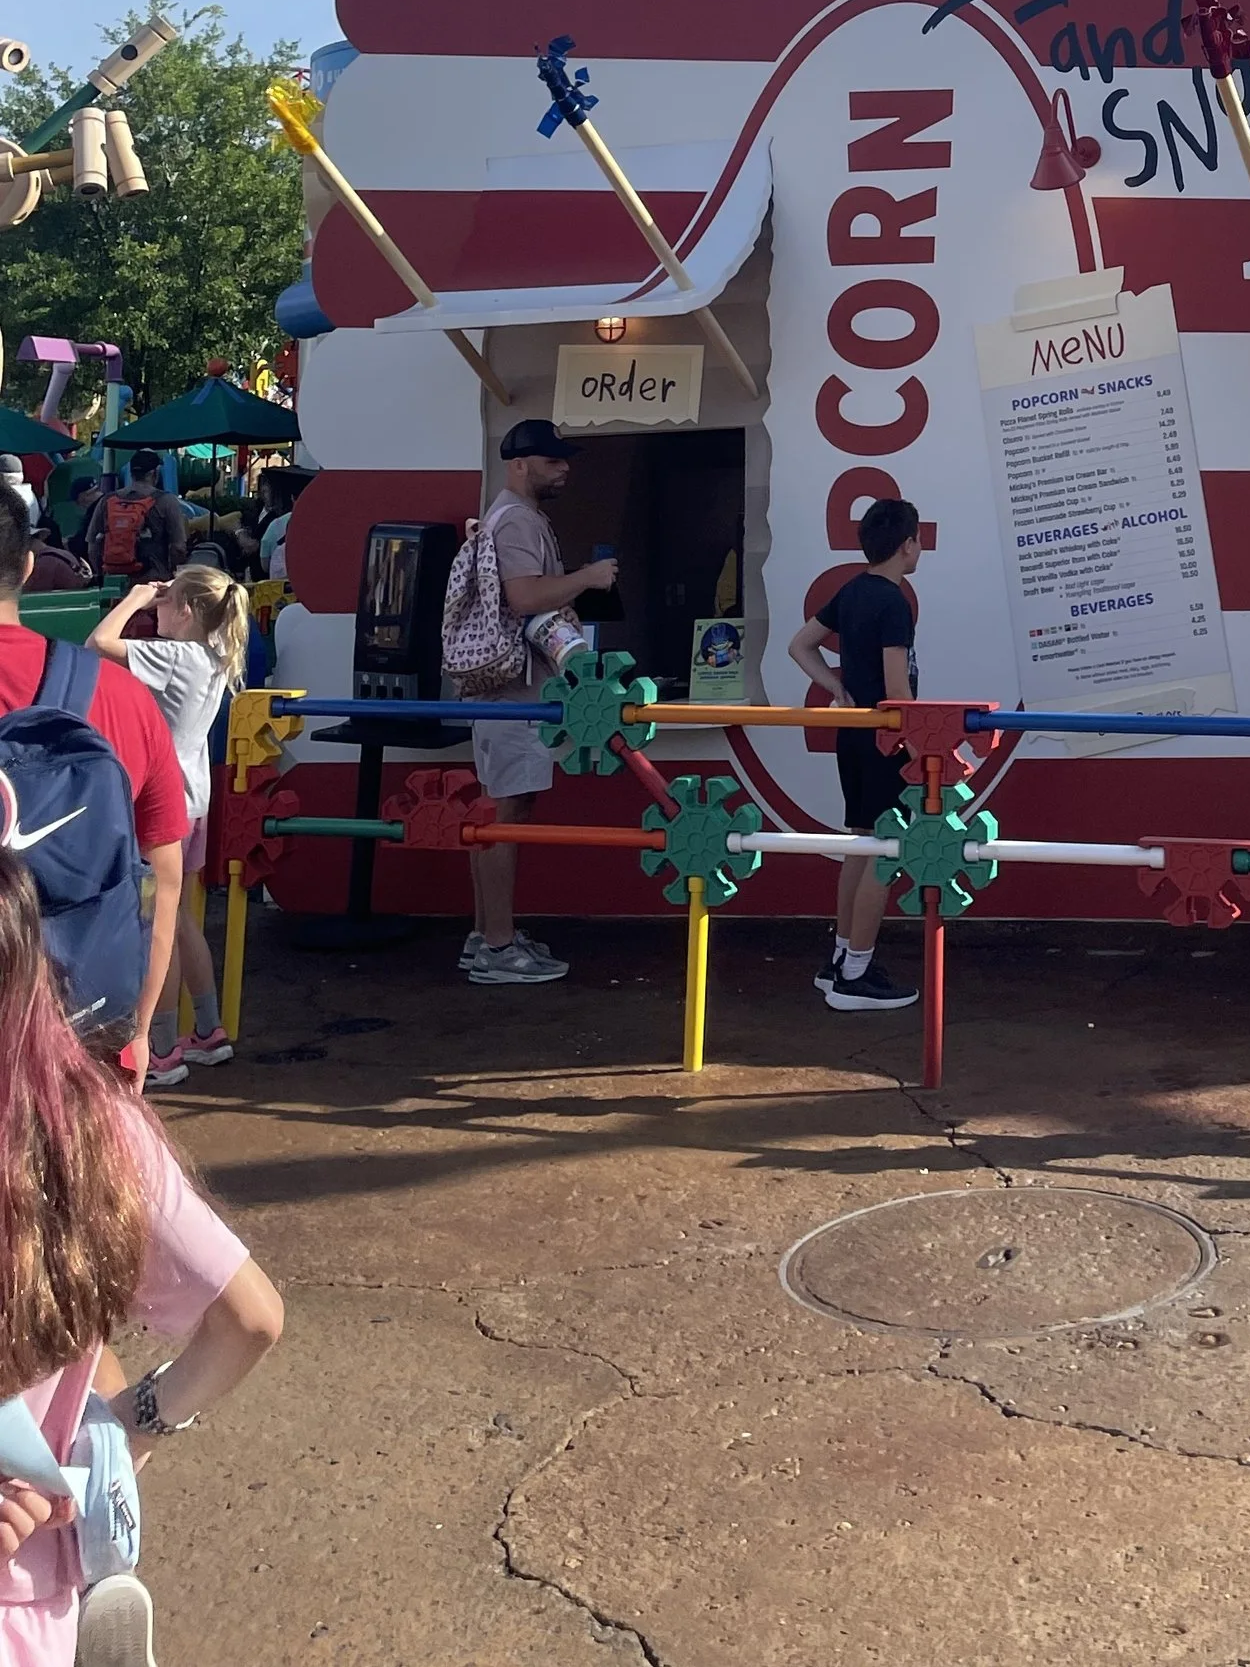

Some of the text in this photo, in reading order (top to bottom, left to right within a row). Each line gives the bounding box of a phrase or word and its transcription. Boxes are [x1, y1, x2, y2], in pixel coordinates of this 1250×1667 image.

[1012, 388, 1079, 411] POPCORN
[1097, 374, 1153, 395] SNACKS
[1000, 418, 1016, 426] Pizza
[1016, 414, 1036, 422] Planet
[1037, 410, 1057, 420] Spring
[1058, 406, 1073, 415] Rolls
[1004, 446, 1030, 457] Popcorn
[1005, 458, 1031, 468] Popcorn
[1007, 470, 1032, 480] Popcorn
[1037, 476, 1063, 486] Premium
[1075, 470, 1095, 479] Cream
[1096, 467, 1107, 475] Bar
[1039, 488, 1065, 497] Premium
[1076, 482, 1097, 490] Cream
[1098, 476, 1129, 487] Sandwich
[1012, 506, 1032, 515] Frozen
[1033, 500, 1065, 511] Lemonade
[1066, 497, 1079, 506] Cup
[1014, 518, 1034, 527] Frozen
[1035, 512, 1066, 523] Lemonade
[1067, 505, 1102, 518] Strawberry
[1103, 502, 1116, 512] Cup
[1017, 522, 1099, 548] BEVERAGES
[1121, 507, 1188, 530] ALCOHOL
[1018, 552, 1032, 560] Jack
[1086, 540, 1100, 548] with
[1044, 558, 1070, 569] Superior
[1086, 552, 1100, 560] with
[1036, 571, 1057, 581] Vanilla
[1058, 568, 1078, 577] Vodka
[1079, 566, 1093, 574] with
[1023, 586, 1039, 596] Draft
[1040, 585, 1054, 593] Beer
[1070, 592, 1154, 617] BEVERAGES
[1066, 633, 1089, 643] Bottled
